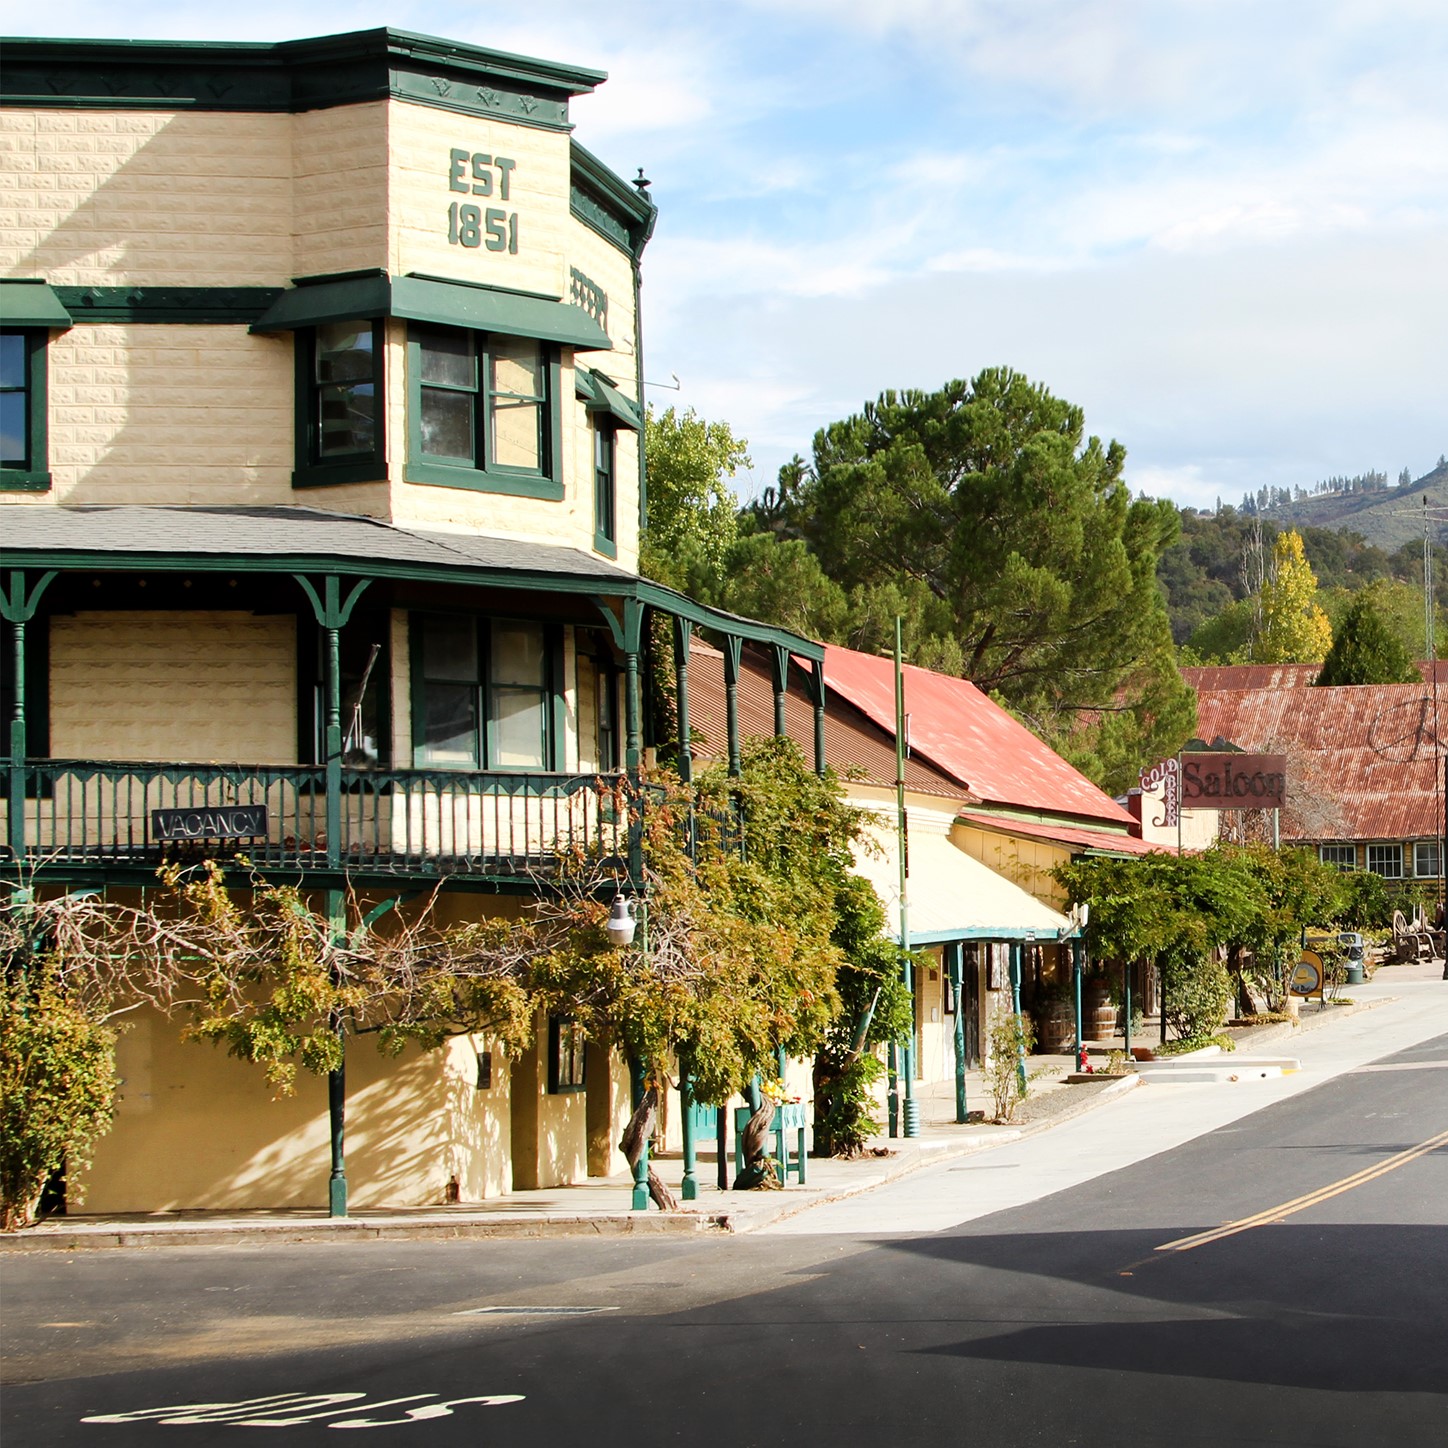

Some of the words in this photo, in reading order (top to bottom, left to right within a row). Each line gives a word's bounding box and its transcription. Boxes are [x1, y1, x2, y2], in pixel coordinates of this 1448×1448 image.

[449, 147, 516, 201] EST
[448, 201, 518, 255] 1851
[1141, 758, 1177, 790] COLD
[1183, 761, 1285, 800] Saloon
[1165, 775, 1177, 827] BEER
[159, 811, 260, 837] VACANCY
